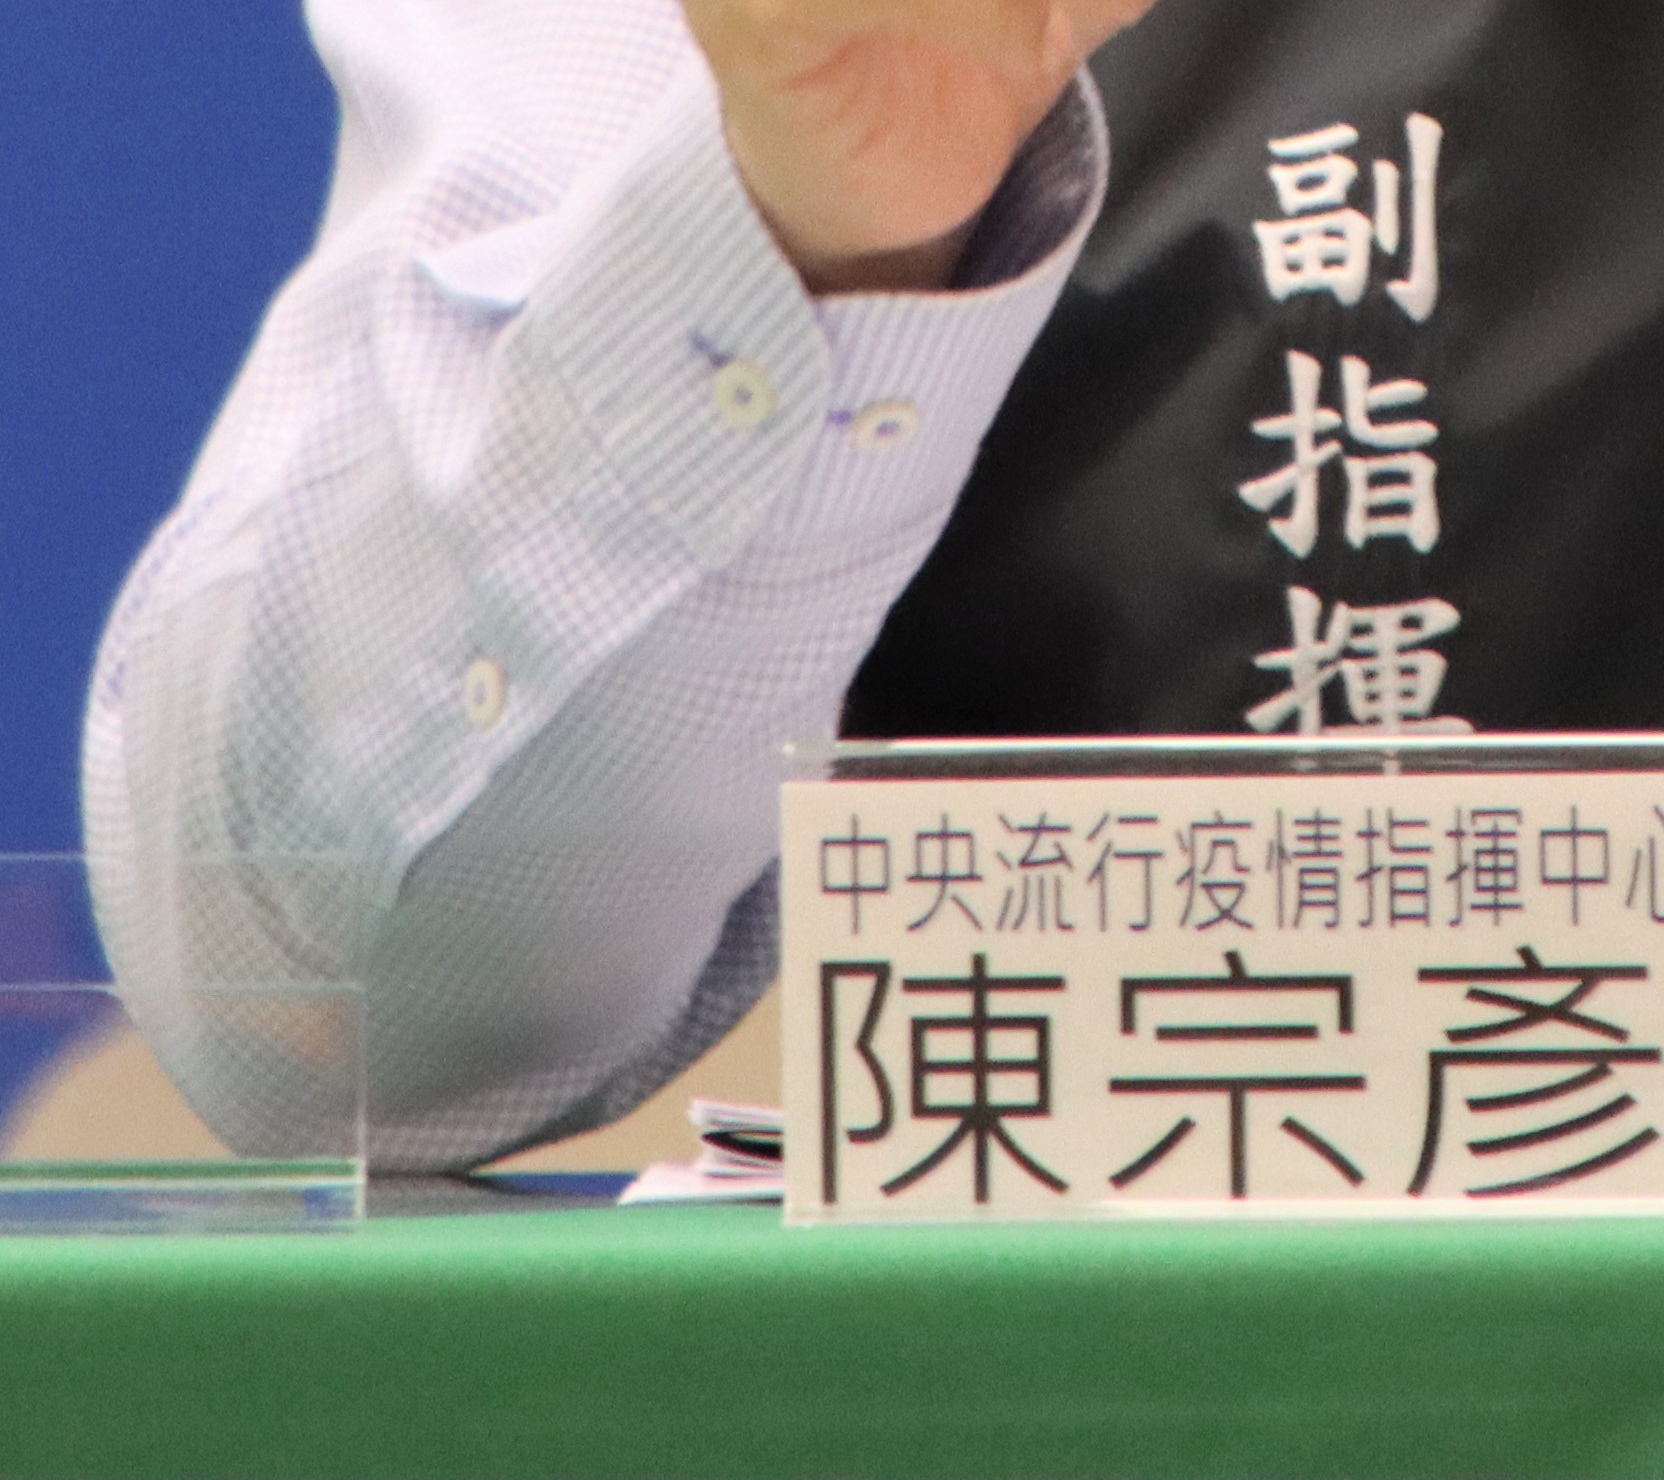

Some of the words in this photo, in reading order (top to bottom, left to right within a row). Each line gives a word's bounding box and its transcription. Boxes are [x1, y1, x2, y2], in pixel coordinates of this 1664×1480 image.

[1236, 111, 1476, 777] 副指揮
[816, 944, 1664, 1206] 陳宗彥
